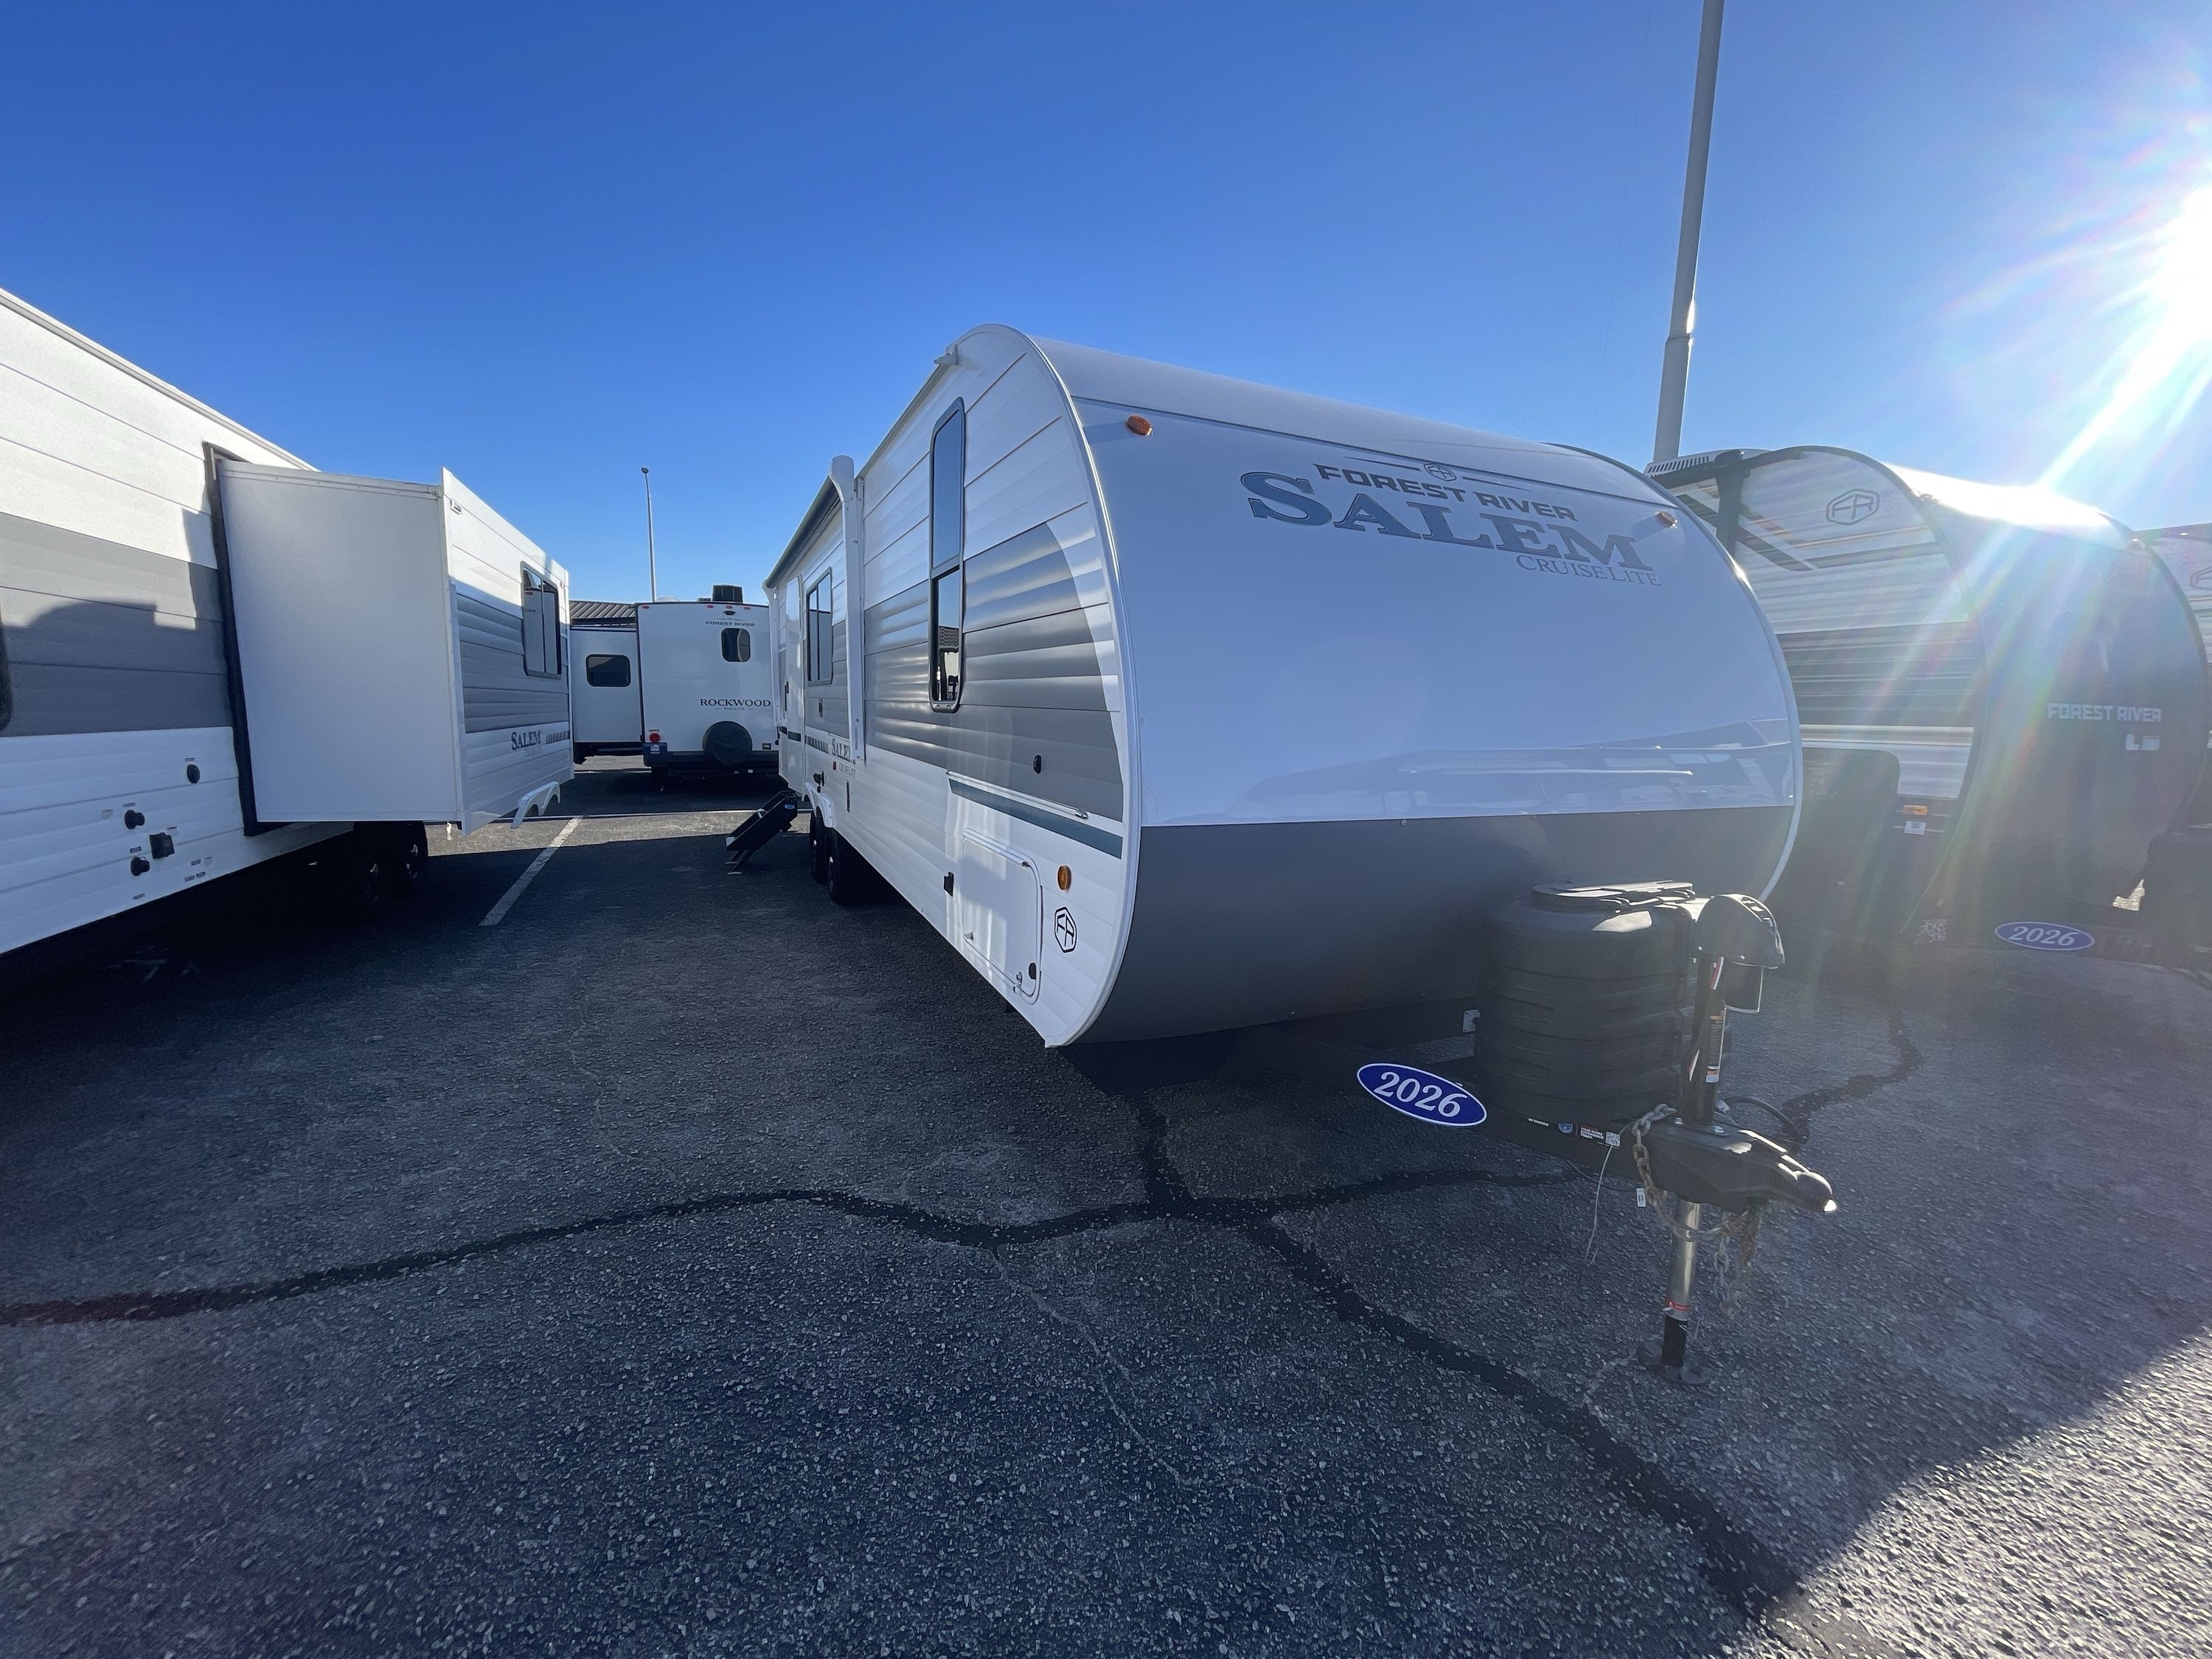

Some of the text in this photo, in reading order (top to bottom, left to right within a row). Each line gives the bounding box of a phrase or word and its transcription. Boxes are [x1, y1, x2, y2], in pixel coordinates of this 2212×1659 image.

[1313, 463, 1579, 522] FOREST RIVER
[1240, 472, 1654, 571] SALEM
[700, 698, 771, 707] ROCKWOOD
[2047, 703, 2162, 723] FOREST RIVER
[511, 730, 542, 751] SALEM
[2007, 925, 2081, 946] 2026
[1374, 1071, 1468, 1117] 2026
